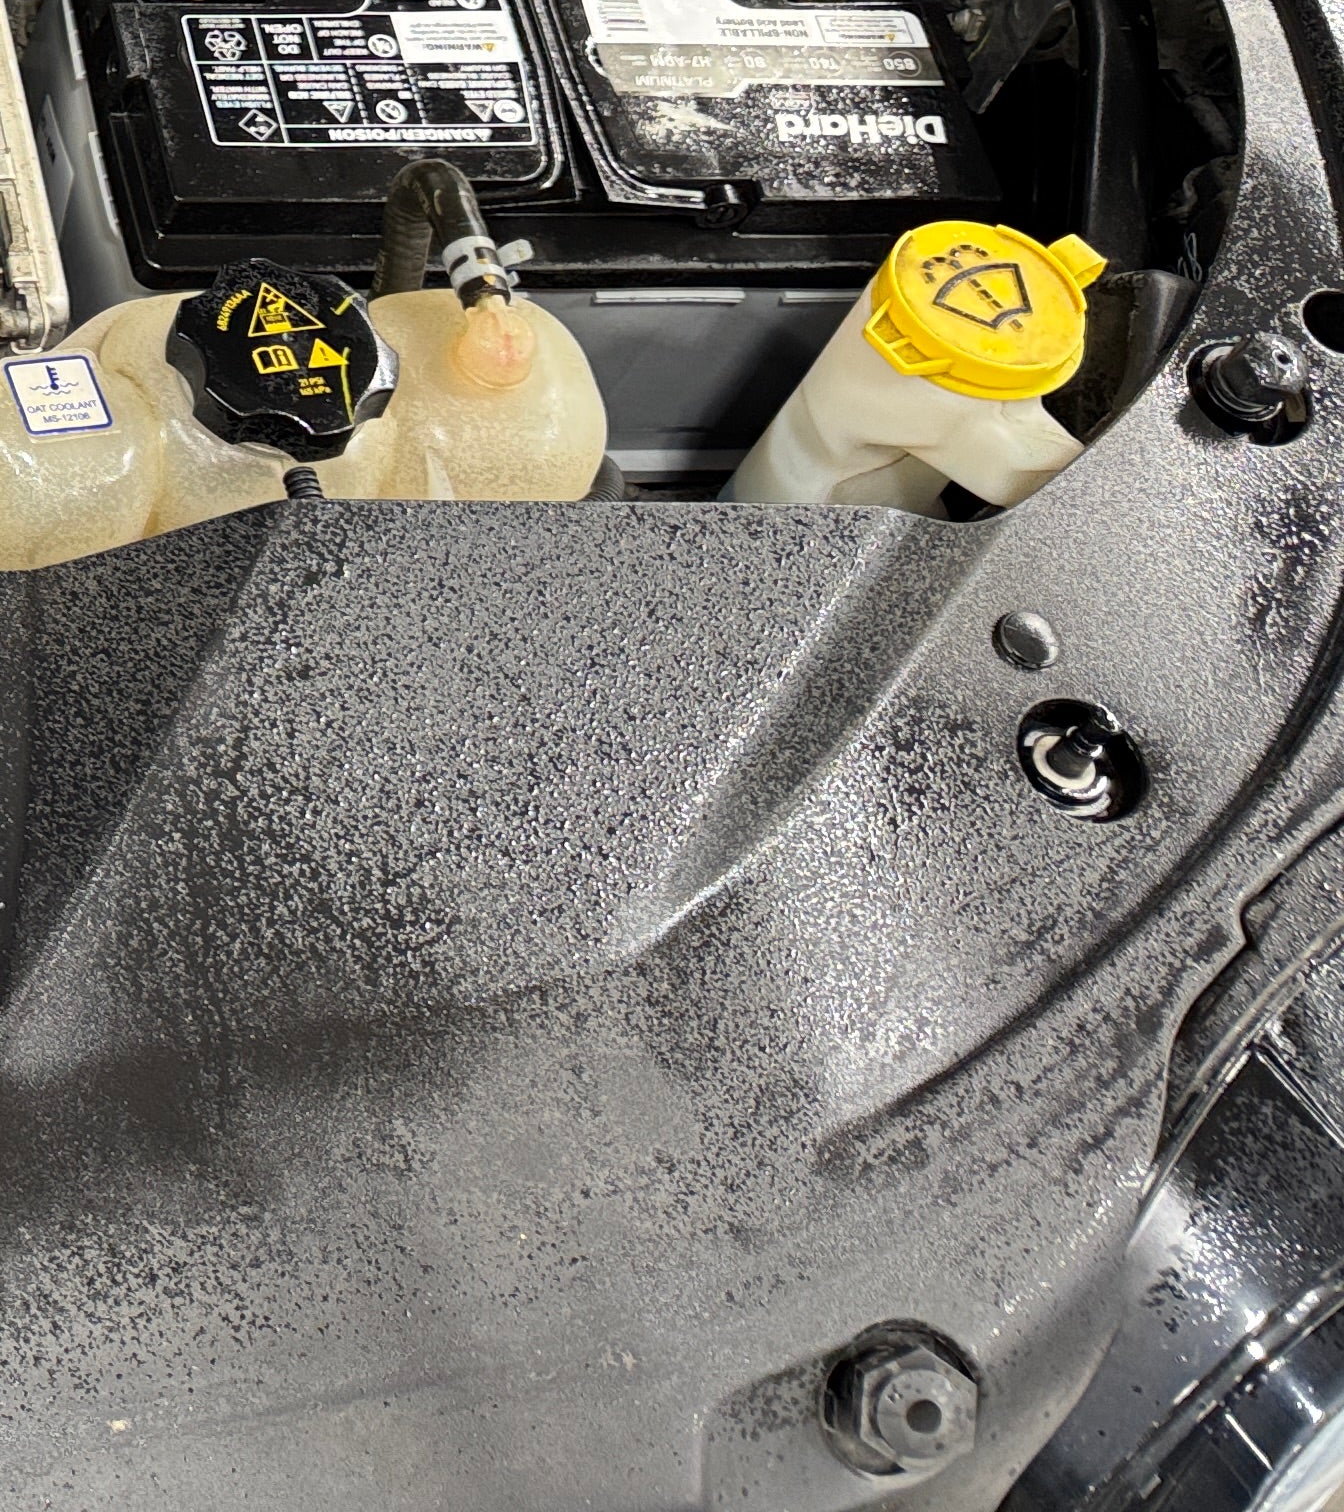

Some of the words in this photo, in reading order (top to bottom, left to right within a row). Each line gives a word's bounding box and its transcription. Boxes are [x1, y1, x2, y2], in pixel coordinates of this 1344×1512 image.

[272, 34, 302, 43] NOT
[278, 45, 301, 54] DO
[883, 58, 916, 70] 850
[635, 76, 713, 88] PLATINUM
[775, 115, 948, 145] DieHard
[27, 404, 47, 414] OAT
[49, 400, 97, 411] COOLANT
